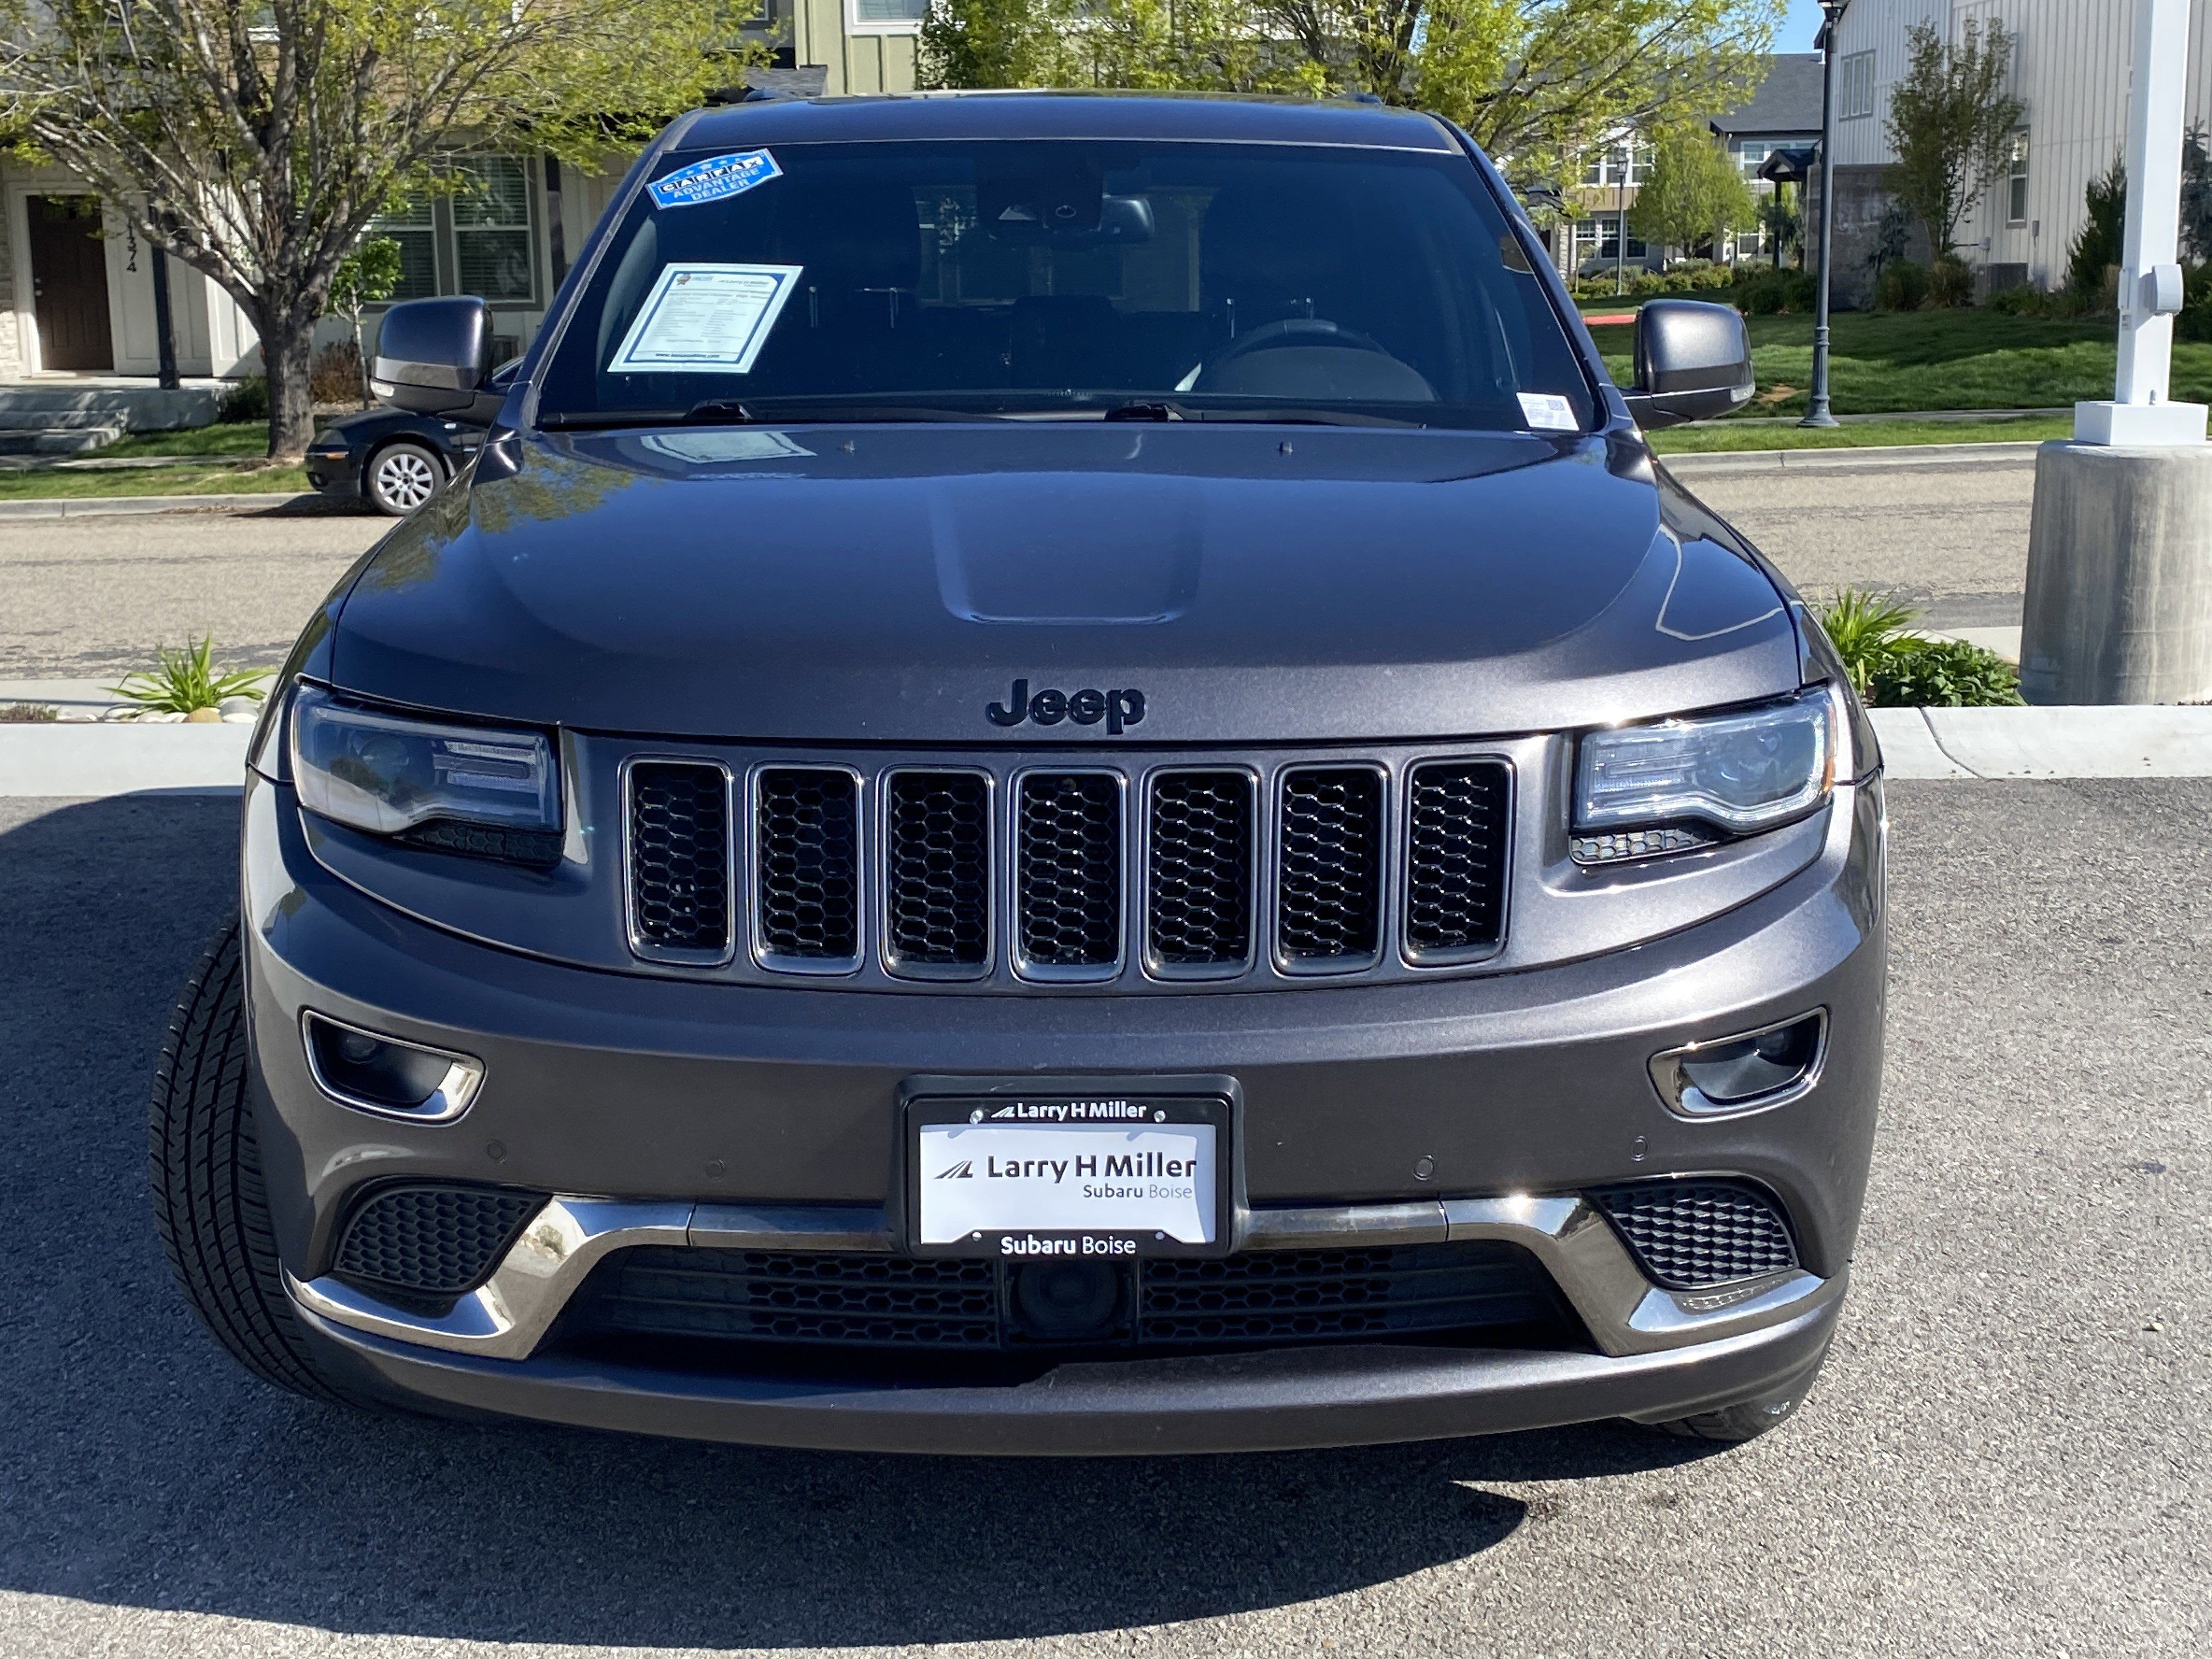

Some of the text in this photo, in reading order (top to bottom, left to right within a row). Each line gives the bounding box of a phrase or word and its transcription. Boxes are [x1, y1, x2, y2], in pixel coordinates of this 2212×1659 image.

[661, 157, 763, 193] CARFAX
[674, 168, 760, 198] ADVANTAGE
[691, 179, 751, 200] DEALER
[985, 679, 1146, 735] Jeep
[1017, 1101, 1147, 1121] Larry H Miller
[988, 1152, 1197, 1183] Larry H Miller
[1083, 1183, 1193, 1199] Subaru Boise
[1001, 1234, 1136, 1255] Subaru Boise
